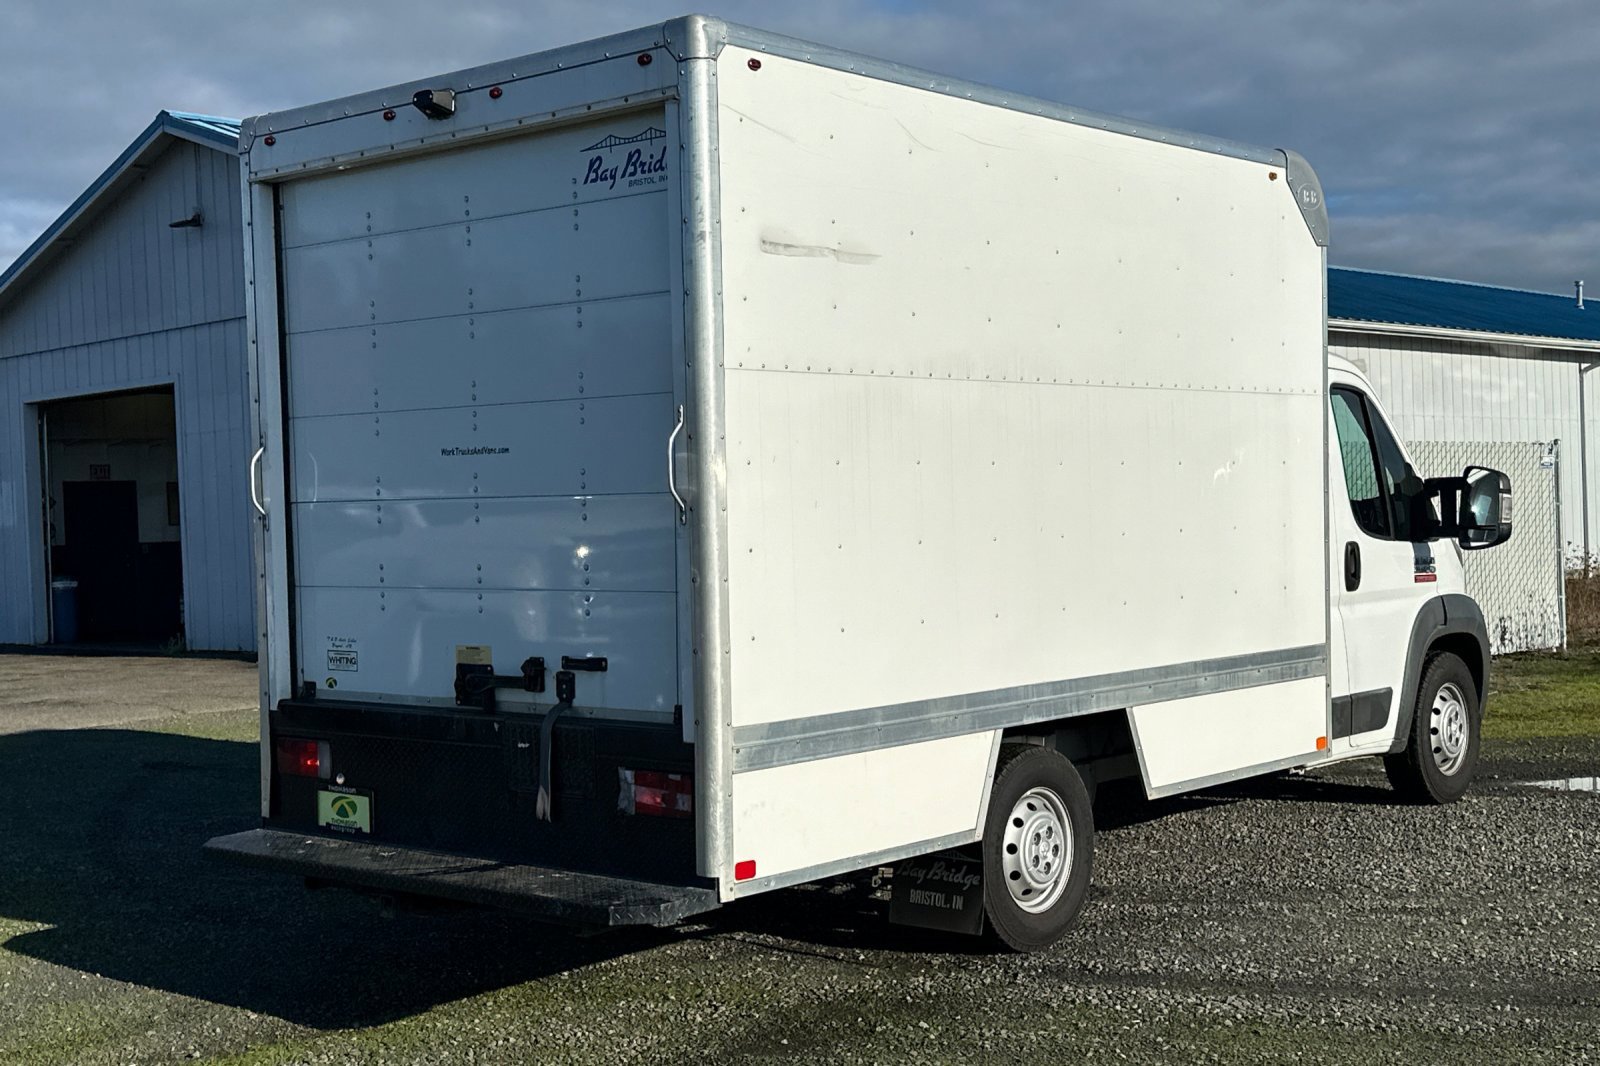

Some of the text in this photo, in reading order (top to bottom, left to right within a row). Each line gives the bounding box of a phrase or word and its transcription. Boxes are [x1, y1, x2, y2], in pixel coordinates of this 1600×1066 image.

[583, 146, 668, 190] Bay Brid
[328, 656, 356, 666] WHITING
[896, 860, 981, 891] Bay Bridge
[952, 894, 964, 911] IN
